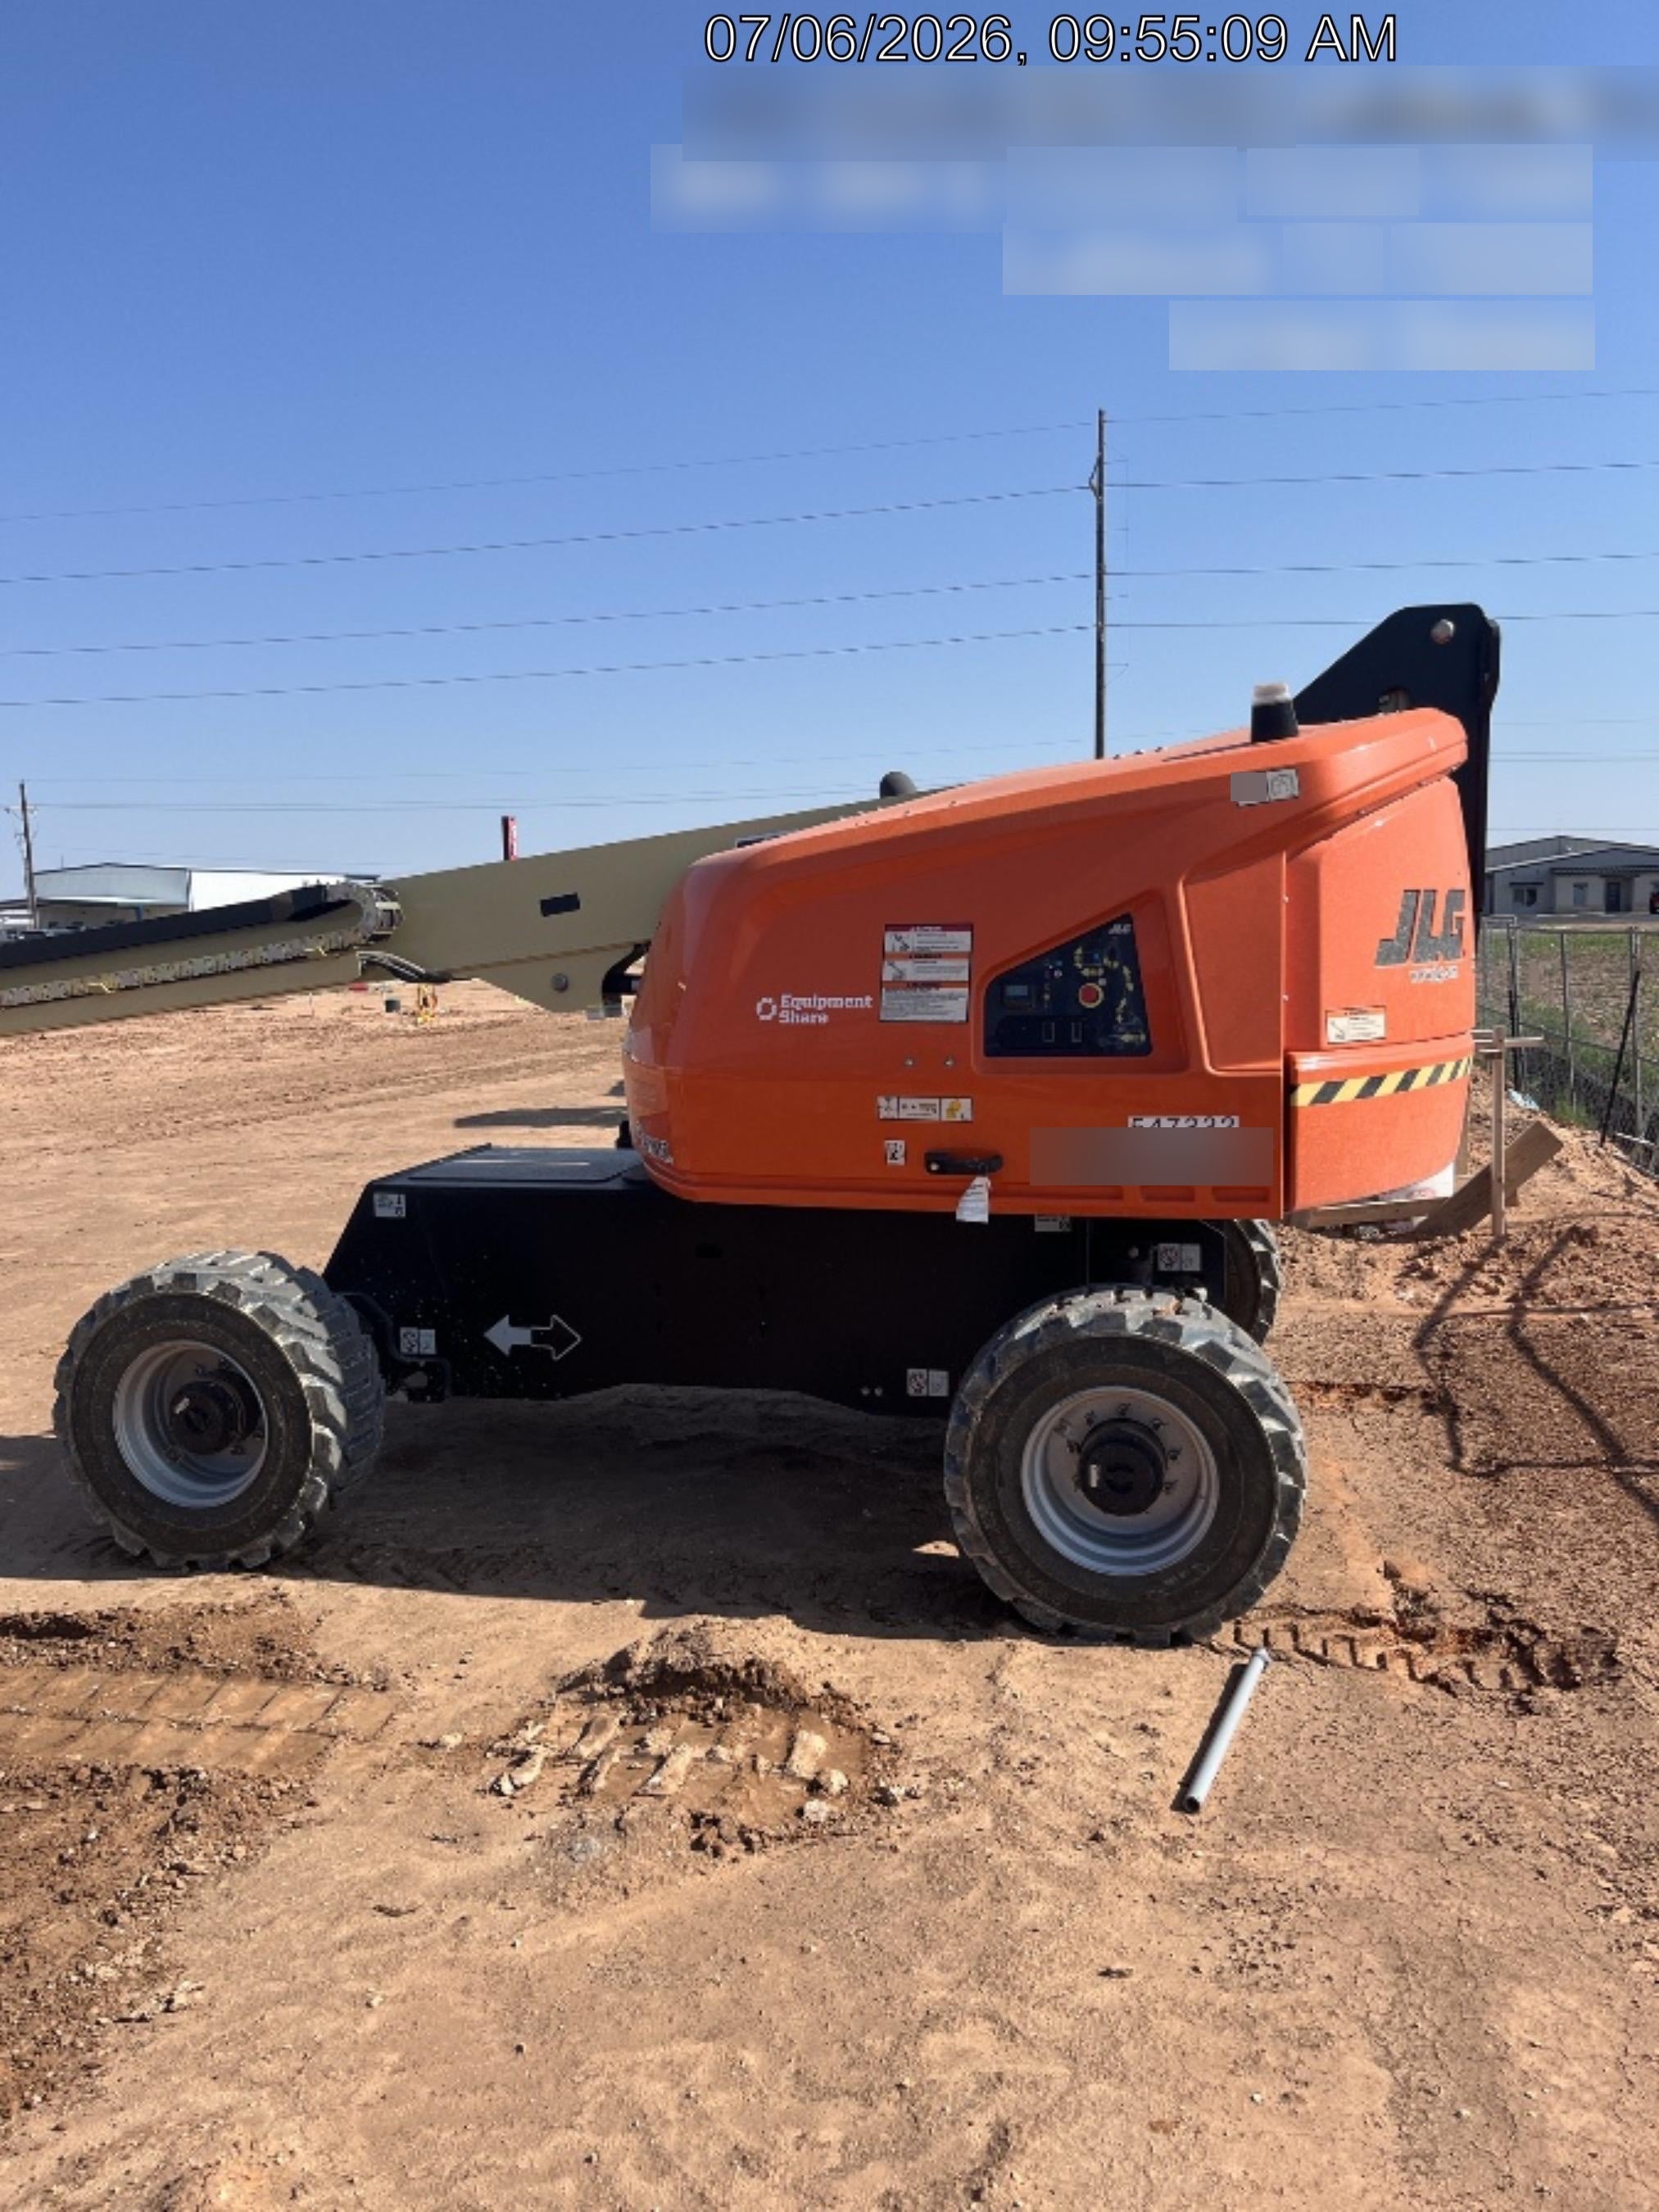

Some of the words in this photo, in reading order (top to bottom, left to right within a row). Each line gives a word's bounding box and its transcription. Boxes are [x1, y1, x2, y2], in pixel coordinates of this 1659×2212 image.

[1374, 889, 1466, 966] JLG
[780, 994, 873, 1010] Equipment
[778, 1010, 829, 1024] Share
